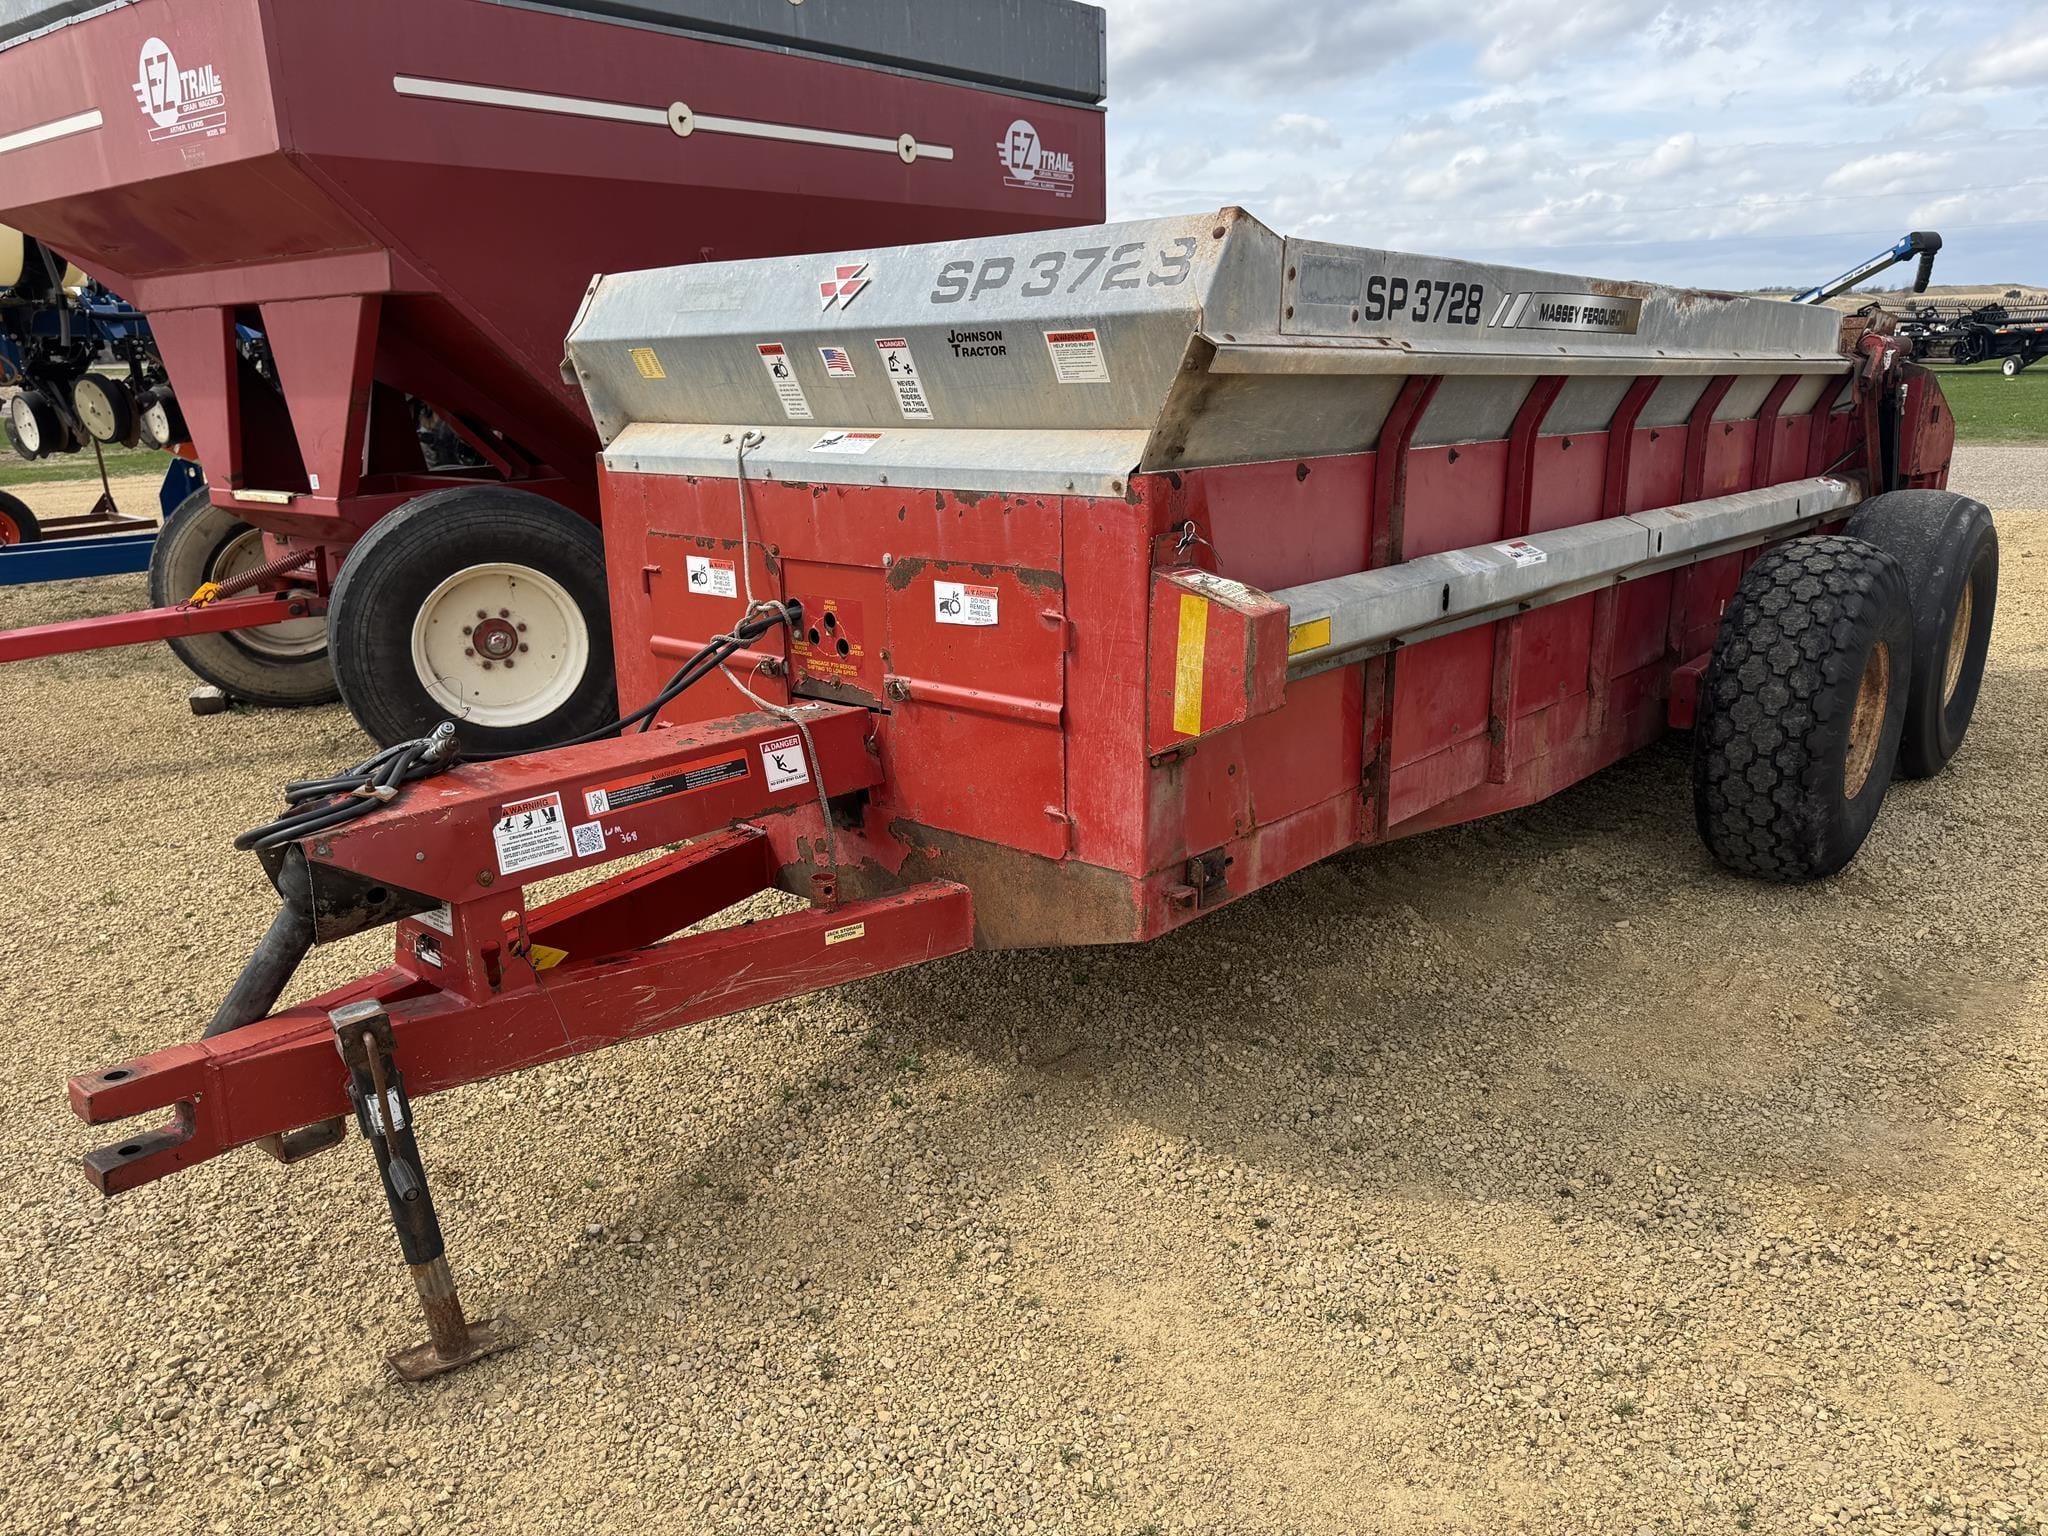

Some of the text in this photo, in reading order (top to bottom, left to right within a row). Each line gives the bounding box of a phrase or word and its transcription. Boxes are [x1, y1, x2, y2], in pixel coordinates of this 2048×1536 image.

[180, 64, 222, 101] TRAIL
[1041, 150, 1074, 172] TRAIL
[931, 256, 1015, 304] SP
[1365, 275, 1484, 325] SP 3728
[1539, 303, 1630, 327] MASSEY FERGUSON
[770, 738, 799, 750] DANGER
[510, 799, 549, 814] WARNING
[509, 826, 552, 840] CRUSHING HAZARD
[620, 831, 638, 843] 368
[834, 931, 857, 940] POSITION
[839, 924, 862, 933] STORAGE
